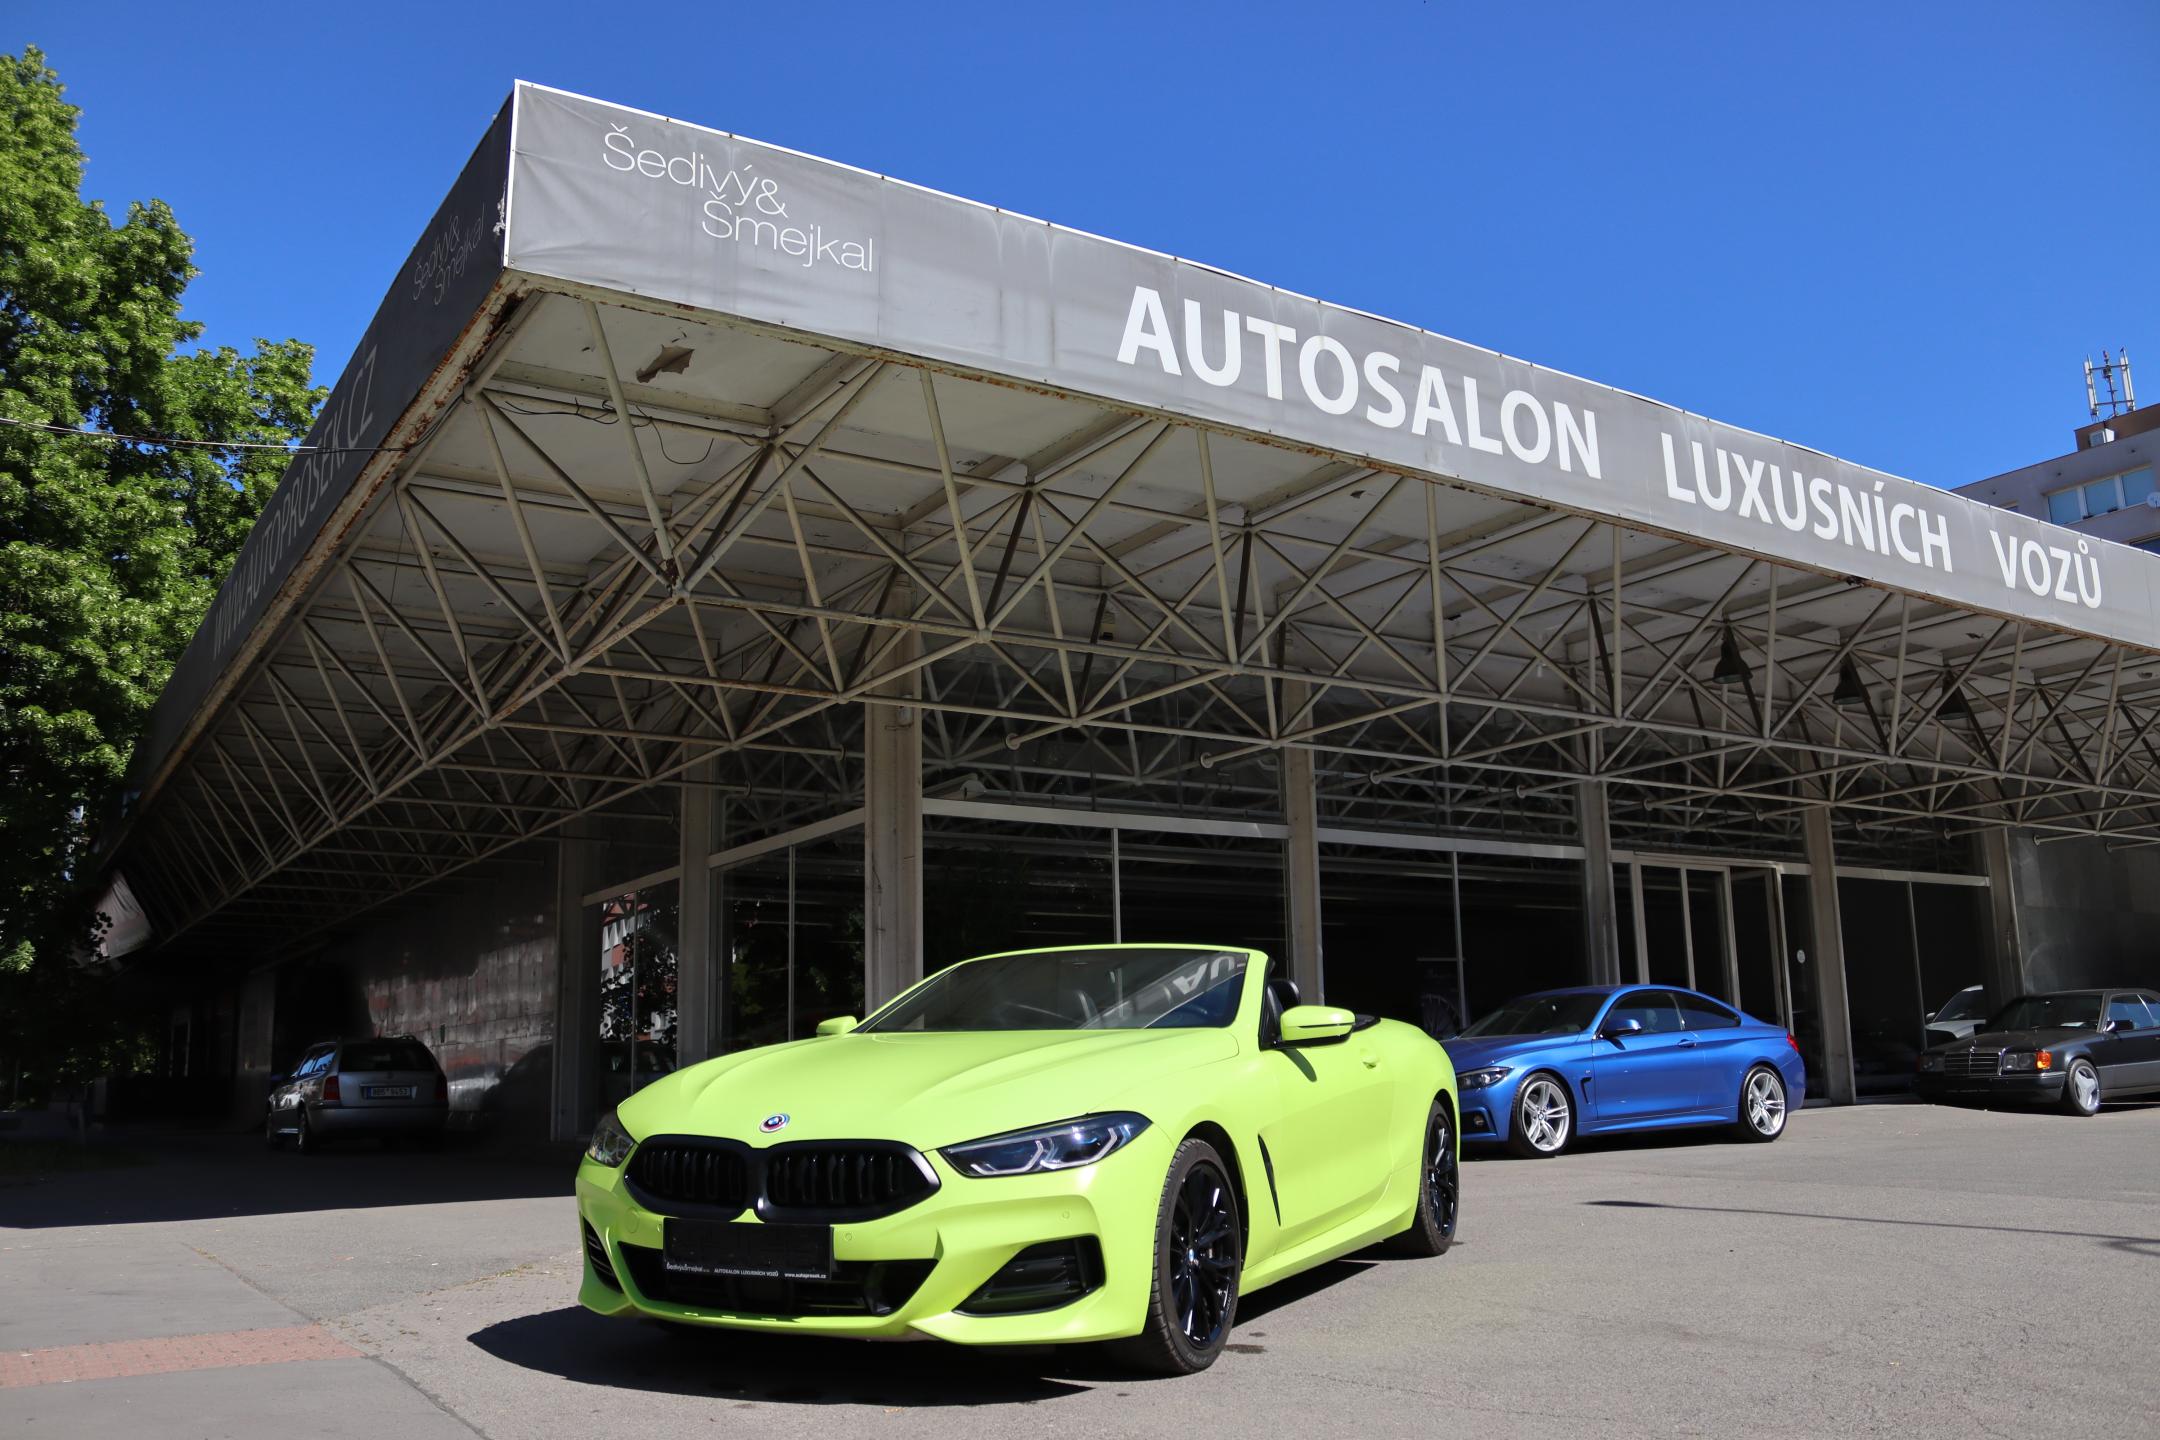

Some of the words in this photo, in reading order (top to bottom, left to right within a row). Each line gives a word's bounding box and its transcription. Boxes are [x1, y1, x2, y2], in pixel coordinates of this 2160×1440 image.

[603, 122, 788, 217] Šedivý&
[702, 191, 873, 272] Šmejkal
[1116, 286, 1602, 480] AUTOSALON
[1661, 433, 1953, 573] LUXUSNÍCH
[1990, 530, 2102, 609] VOZŮ
